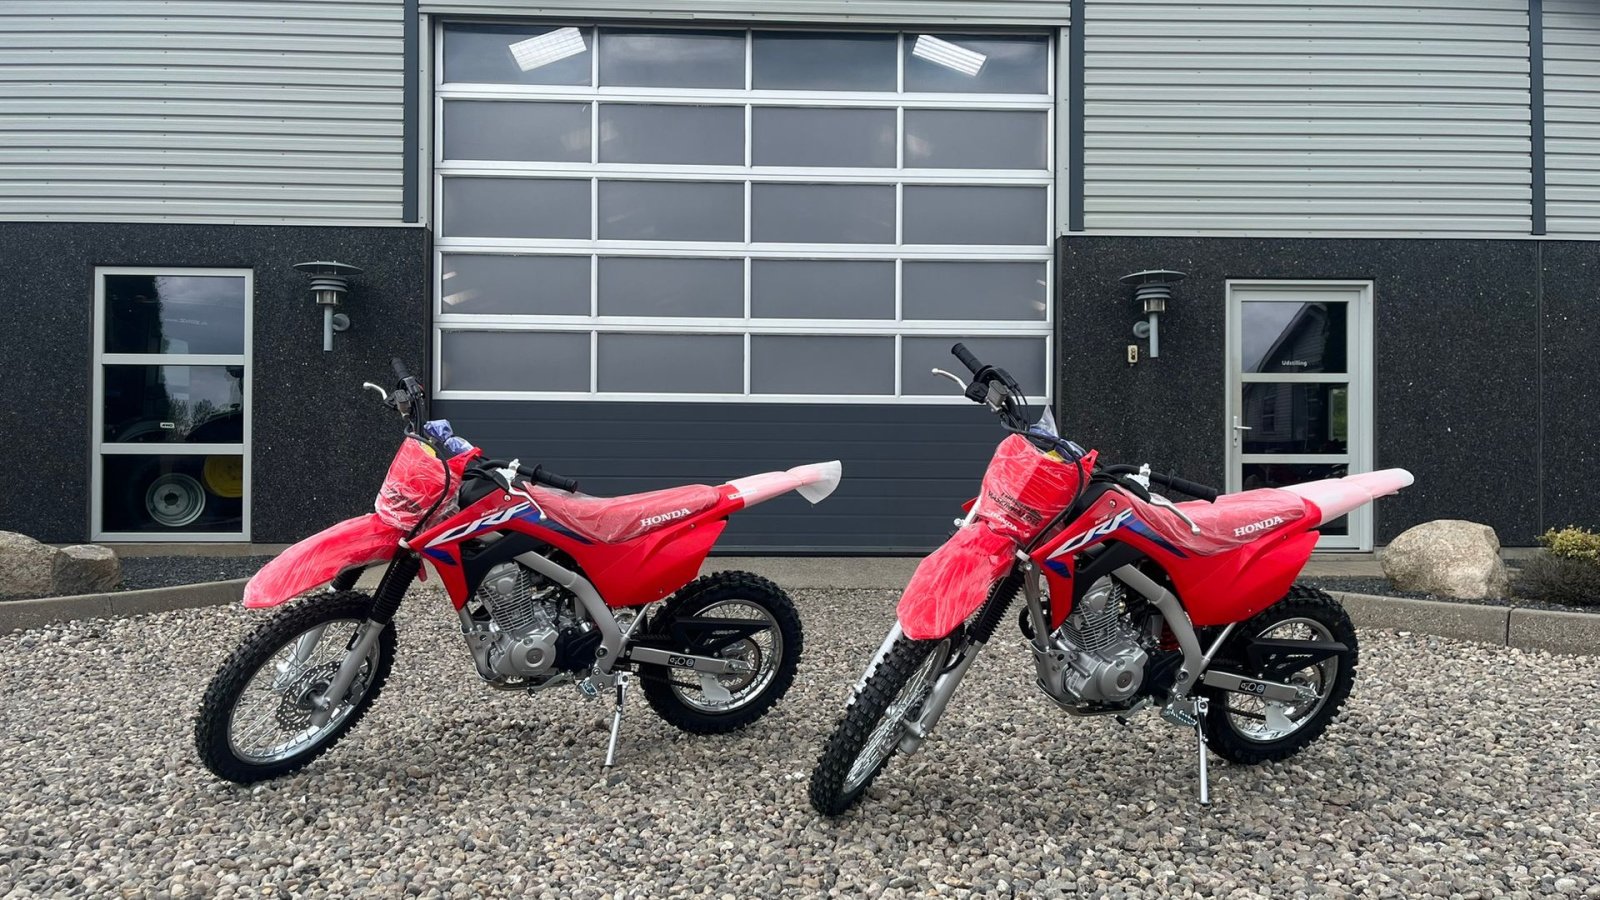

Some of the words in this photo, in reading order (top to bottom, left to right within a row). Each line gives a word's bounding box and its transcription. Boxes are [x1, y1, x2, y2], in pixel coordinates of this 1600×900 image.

[424, 500, 531, 549] CRF
[640, 508, 692, 527] HONDA
[1046, 507, 1134, 560] CRF
[1233, 516, 1284, 537] HONDA
